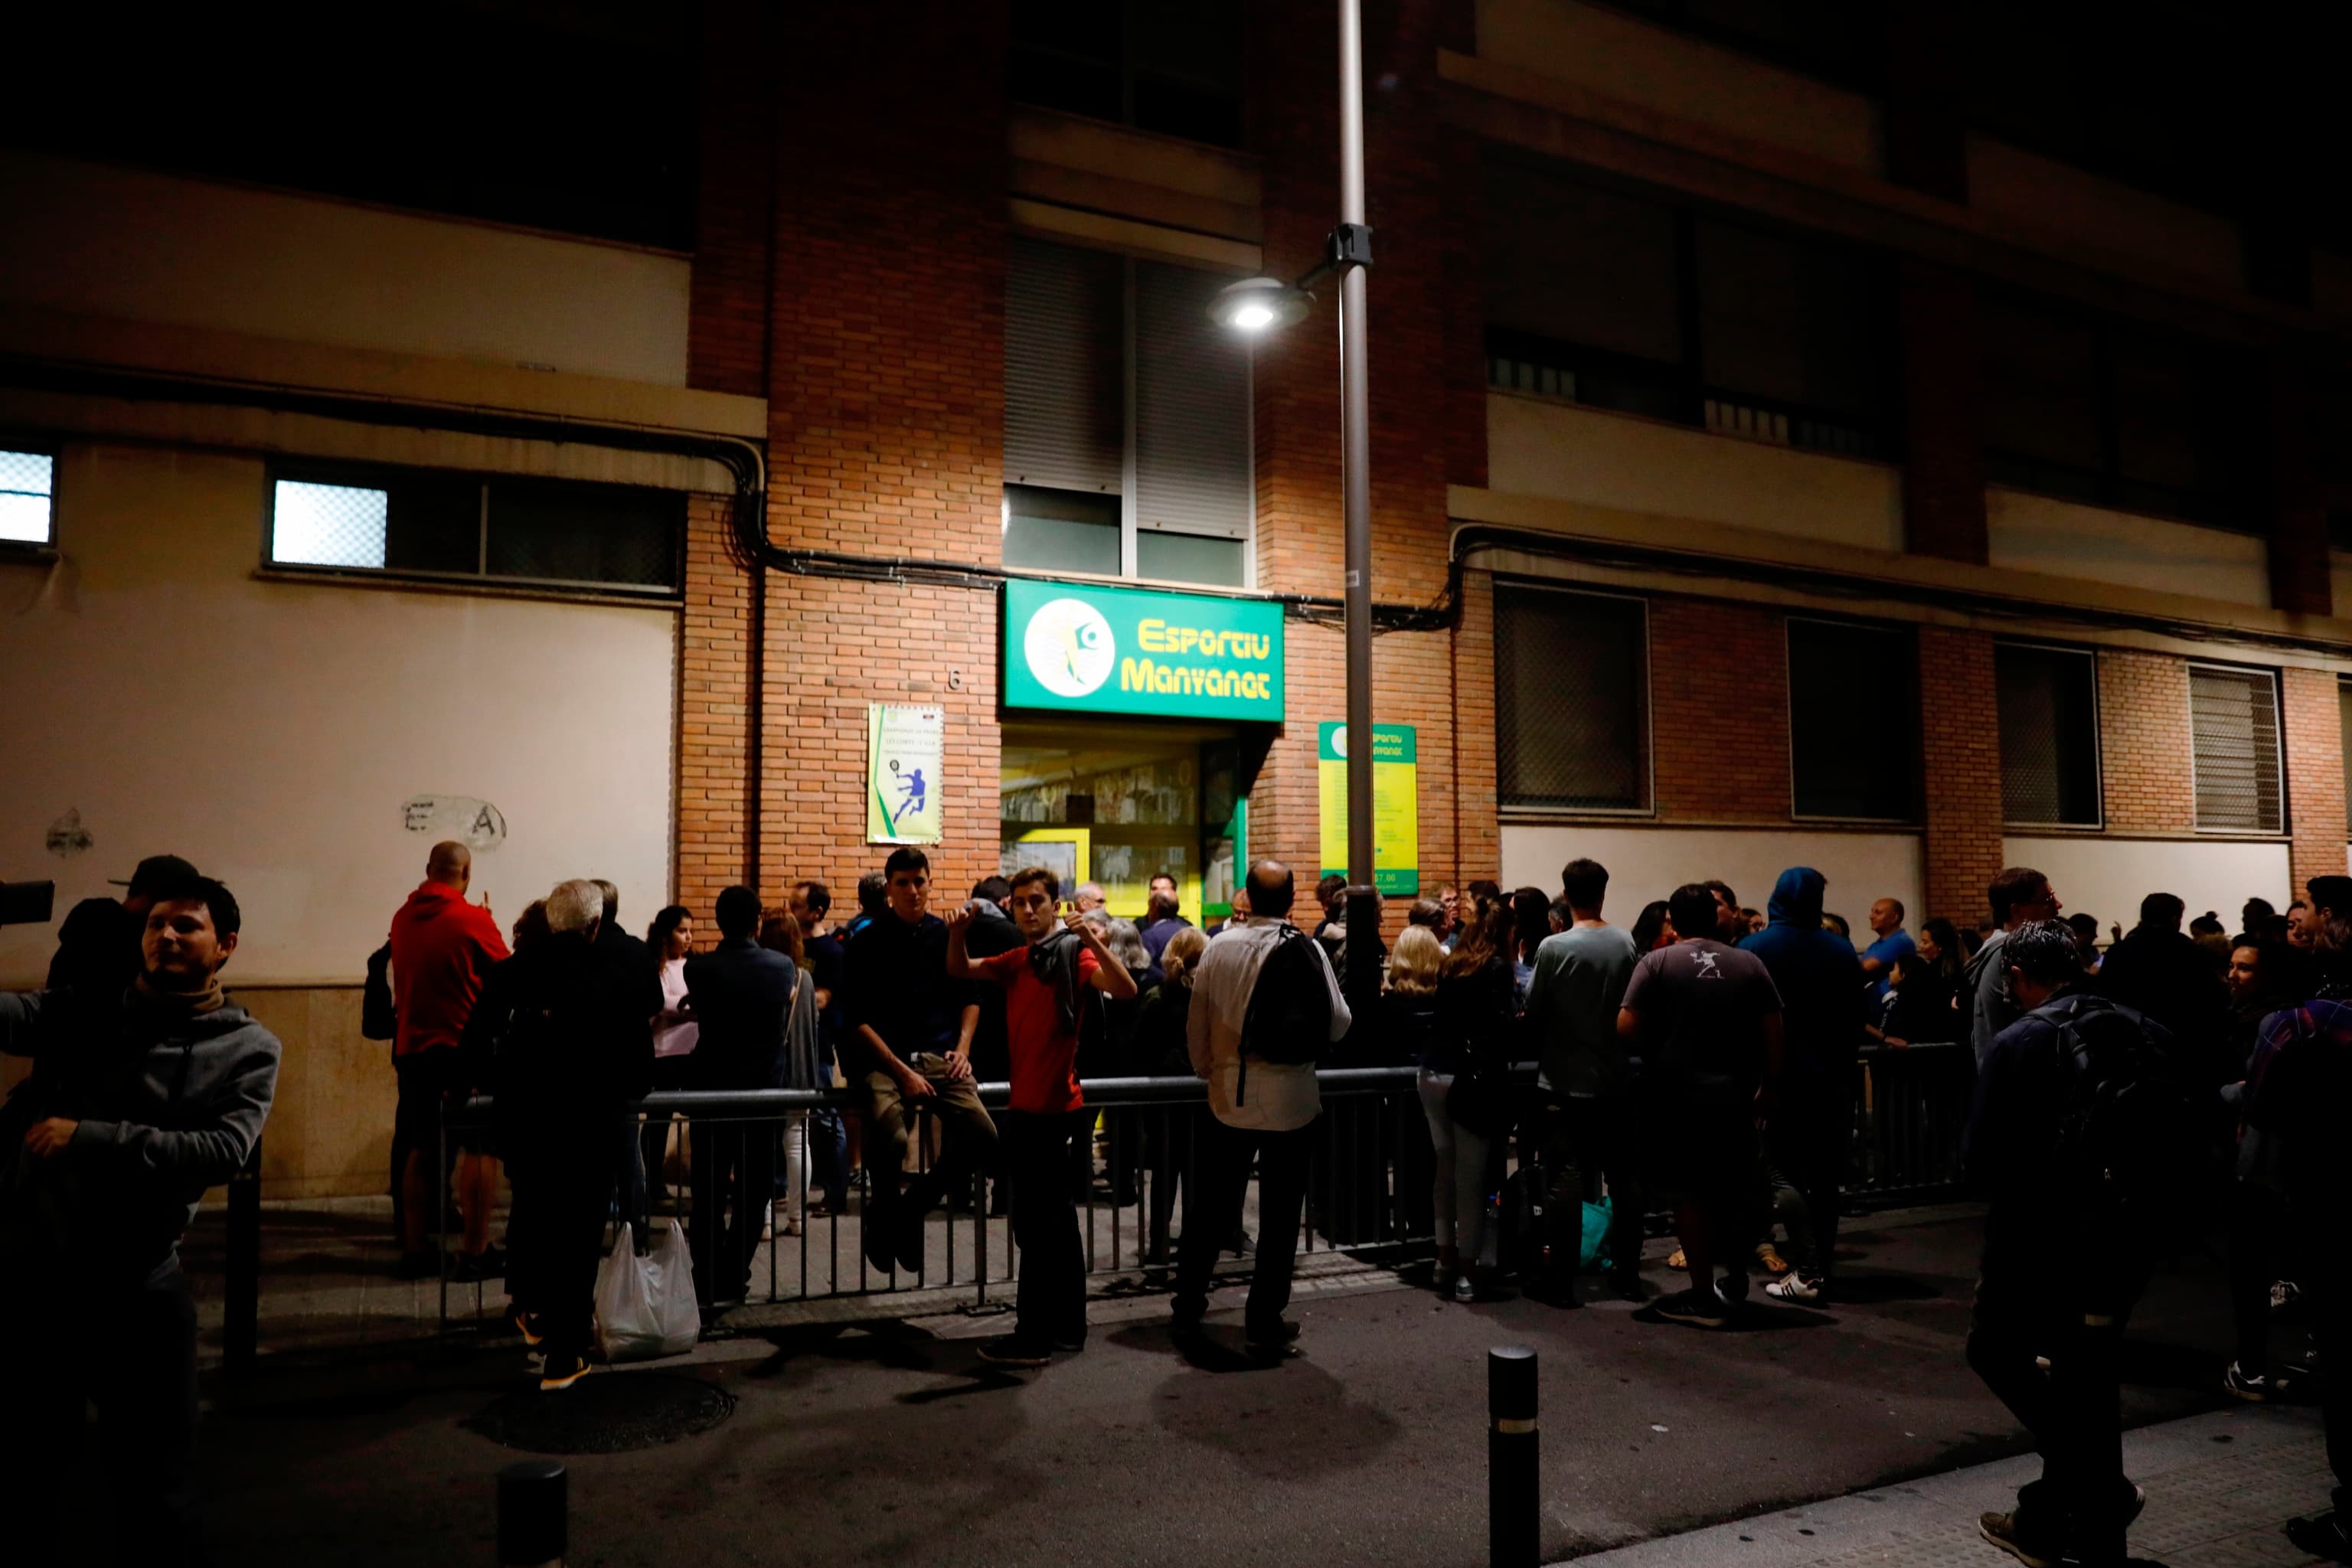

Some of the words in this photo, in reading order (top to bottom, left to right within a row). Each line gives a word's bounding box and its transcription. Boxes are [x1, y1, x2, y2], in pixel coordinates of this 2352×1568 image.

[1138, 619, 1270, 660] Esportiu
[949, 669, 962, 690] 6
[1120, 657, 1270, 700] Manyanet
